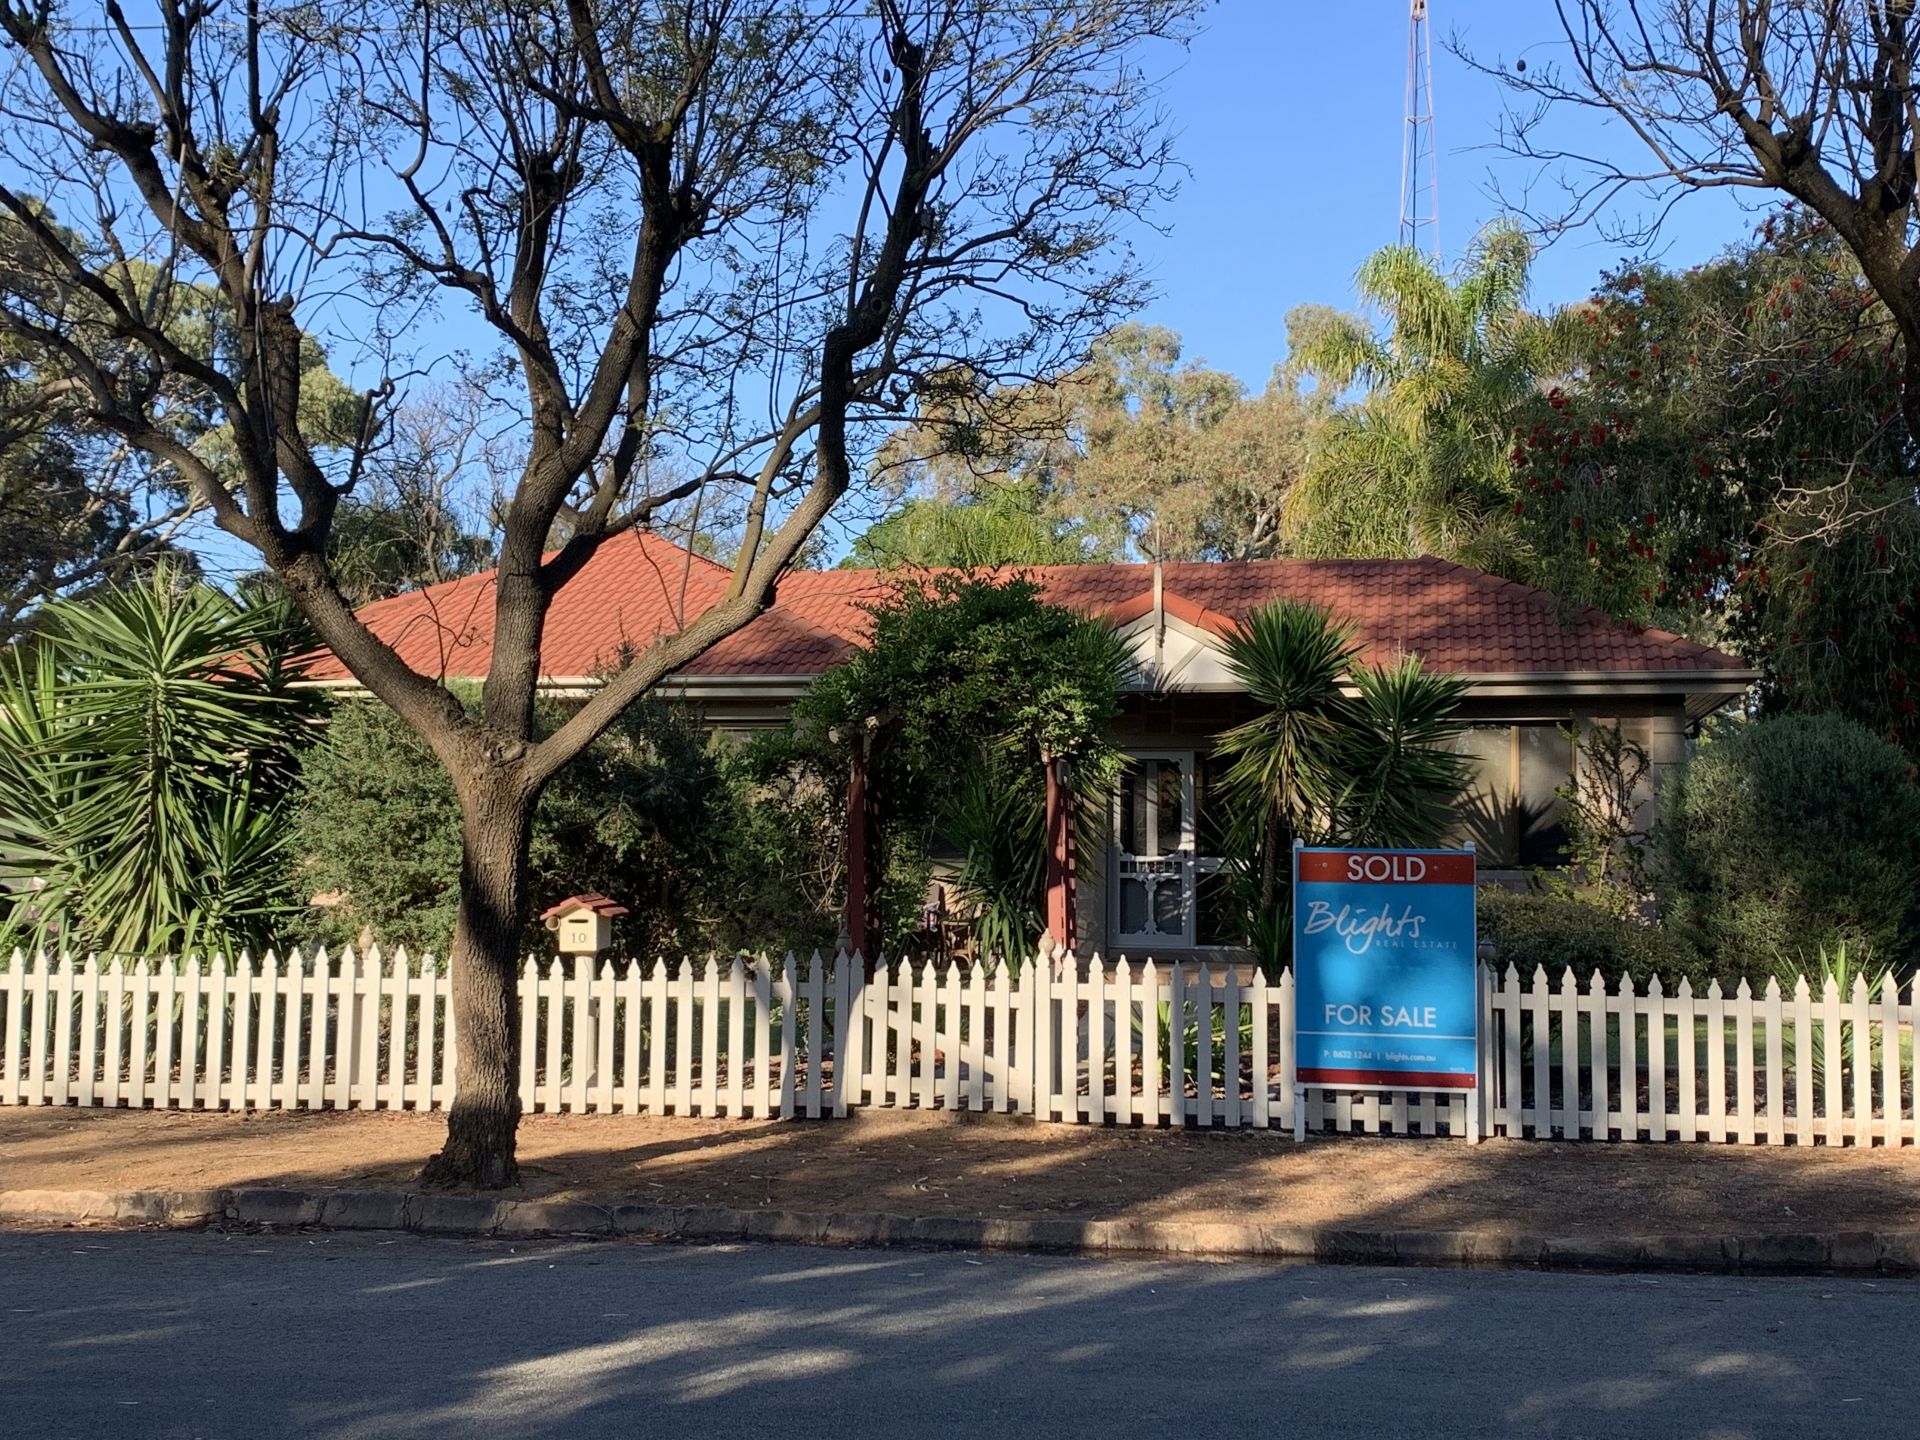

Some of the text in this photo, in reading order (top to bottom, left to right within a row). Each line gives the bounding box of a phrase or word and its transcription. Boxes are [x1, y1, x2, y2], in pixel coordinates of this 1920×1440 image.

[1347, 855, 1427, 881] SOLD
[1303, 901, 1426, 954] Blights
[571, 932, 587, 943] 10
[1375, 938, 1458, 949] REAL ESTATE
[1325, 1004, 1437, 1028] FOR SALE
[1385, 1050, 1437, 1062] blights.com.au
